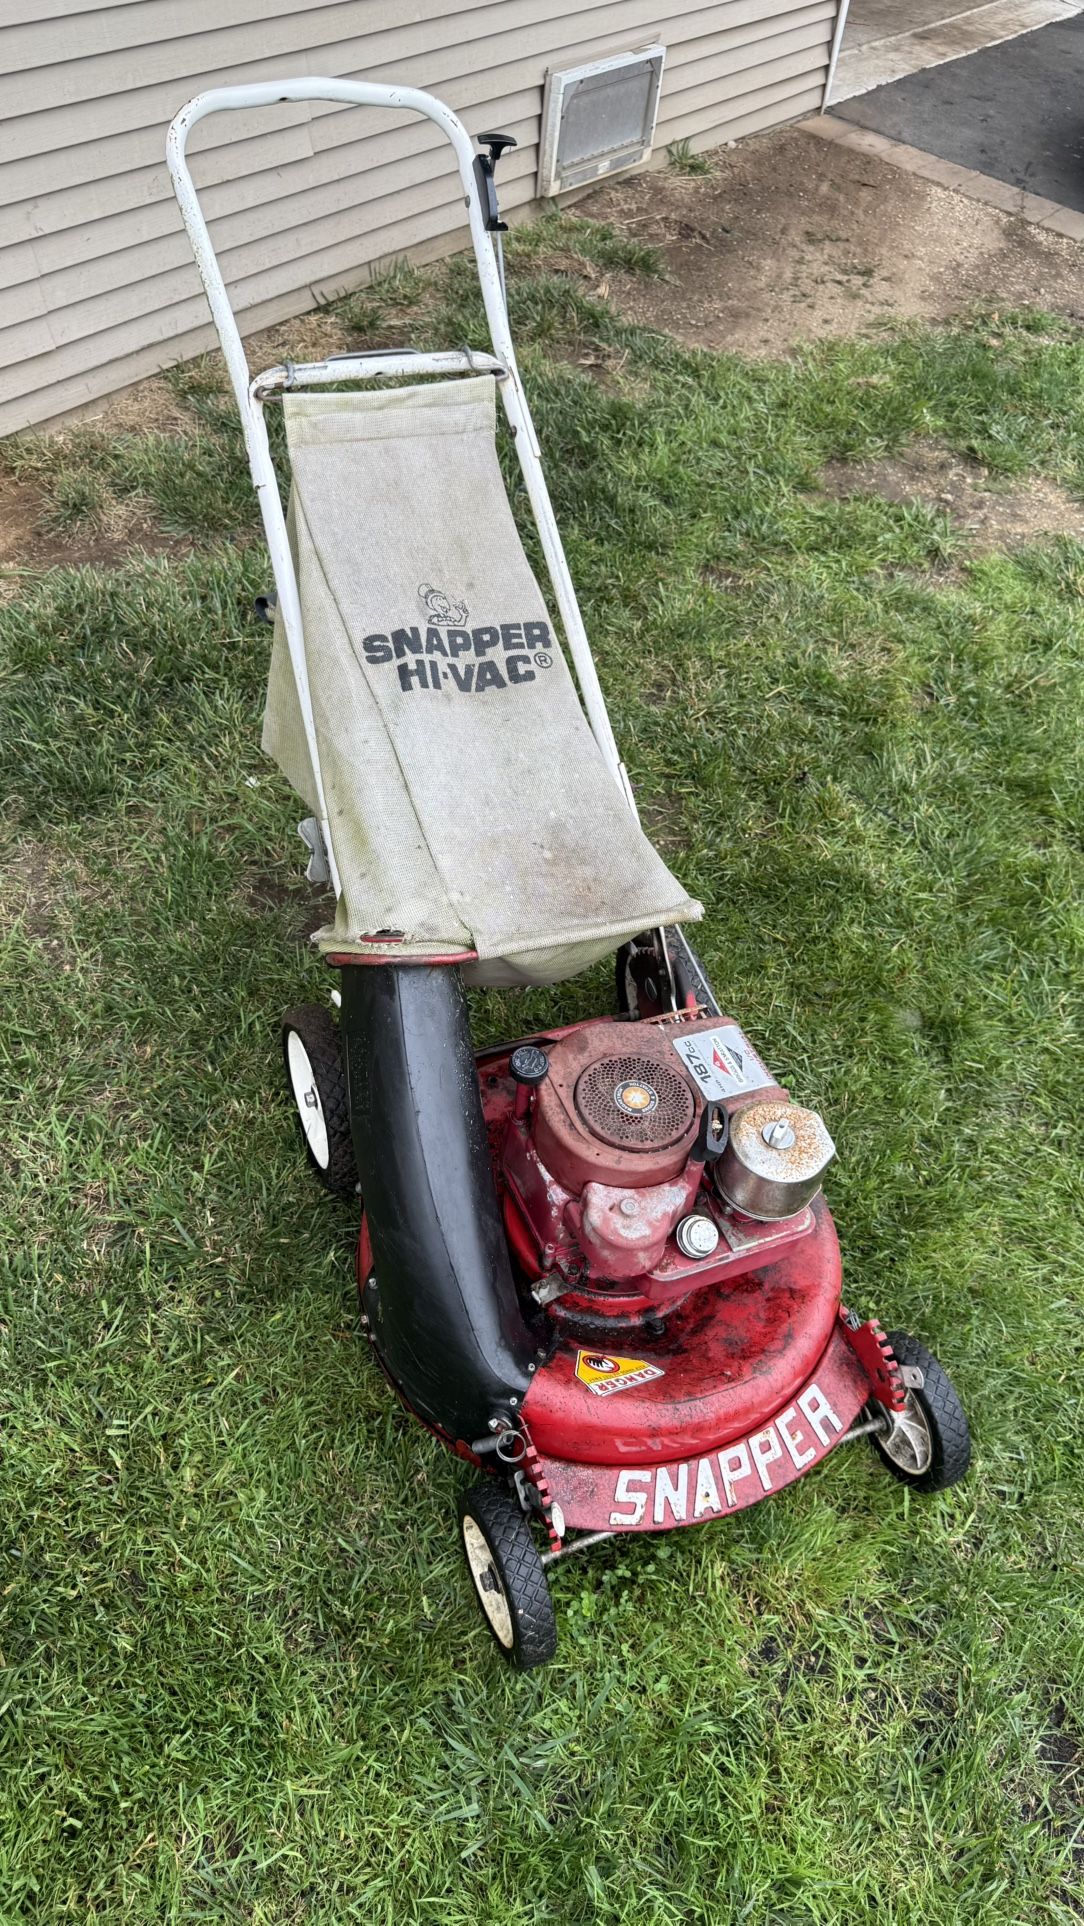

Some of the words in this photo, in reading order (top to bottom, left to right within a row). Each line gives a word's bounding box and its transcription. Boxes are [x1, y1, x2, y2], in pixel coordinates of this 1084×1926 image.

[362, 621, 551, 664] SNAPPER
[684, 1040, 711, 1084] 187cc
[597, 1368, 656, 1391] DANGER
[609, 1383, 844, 1526] SNAPPER
